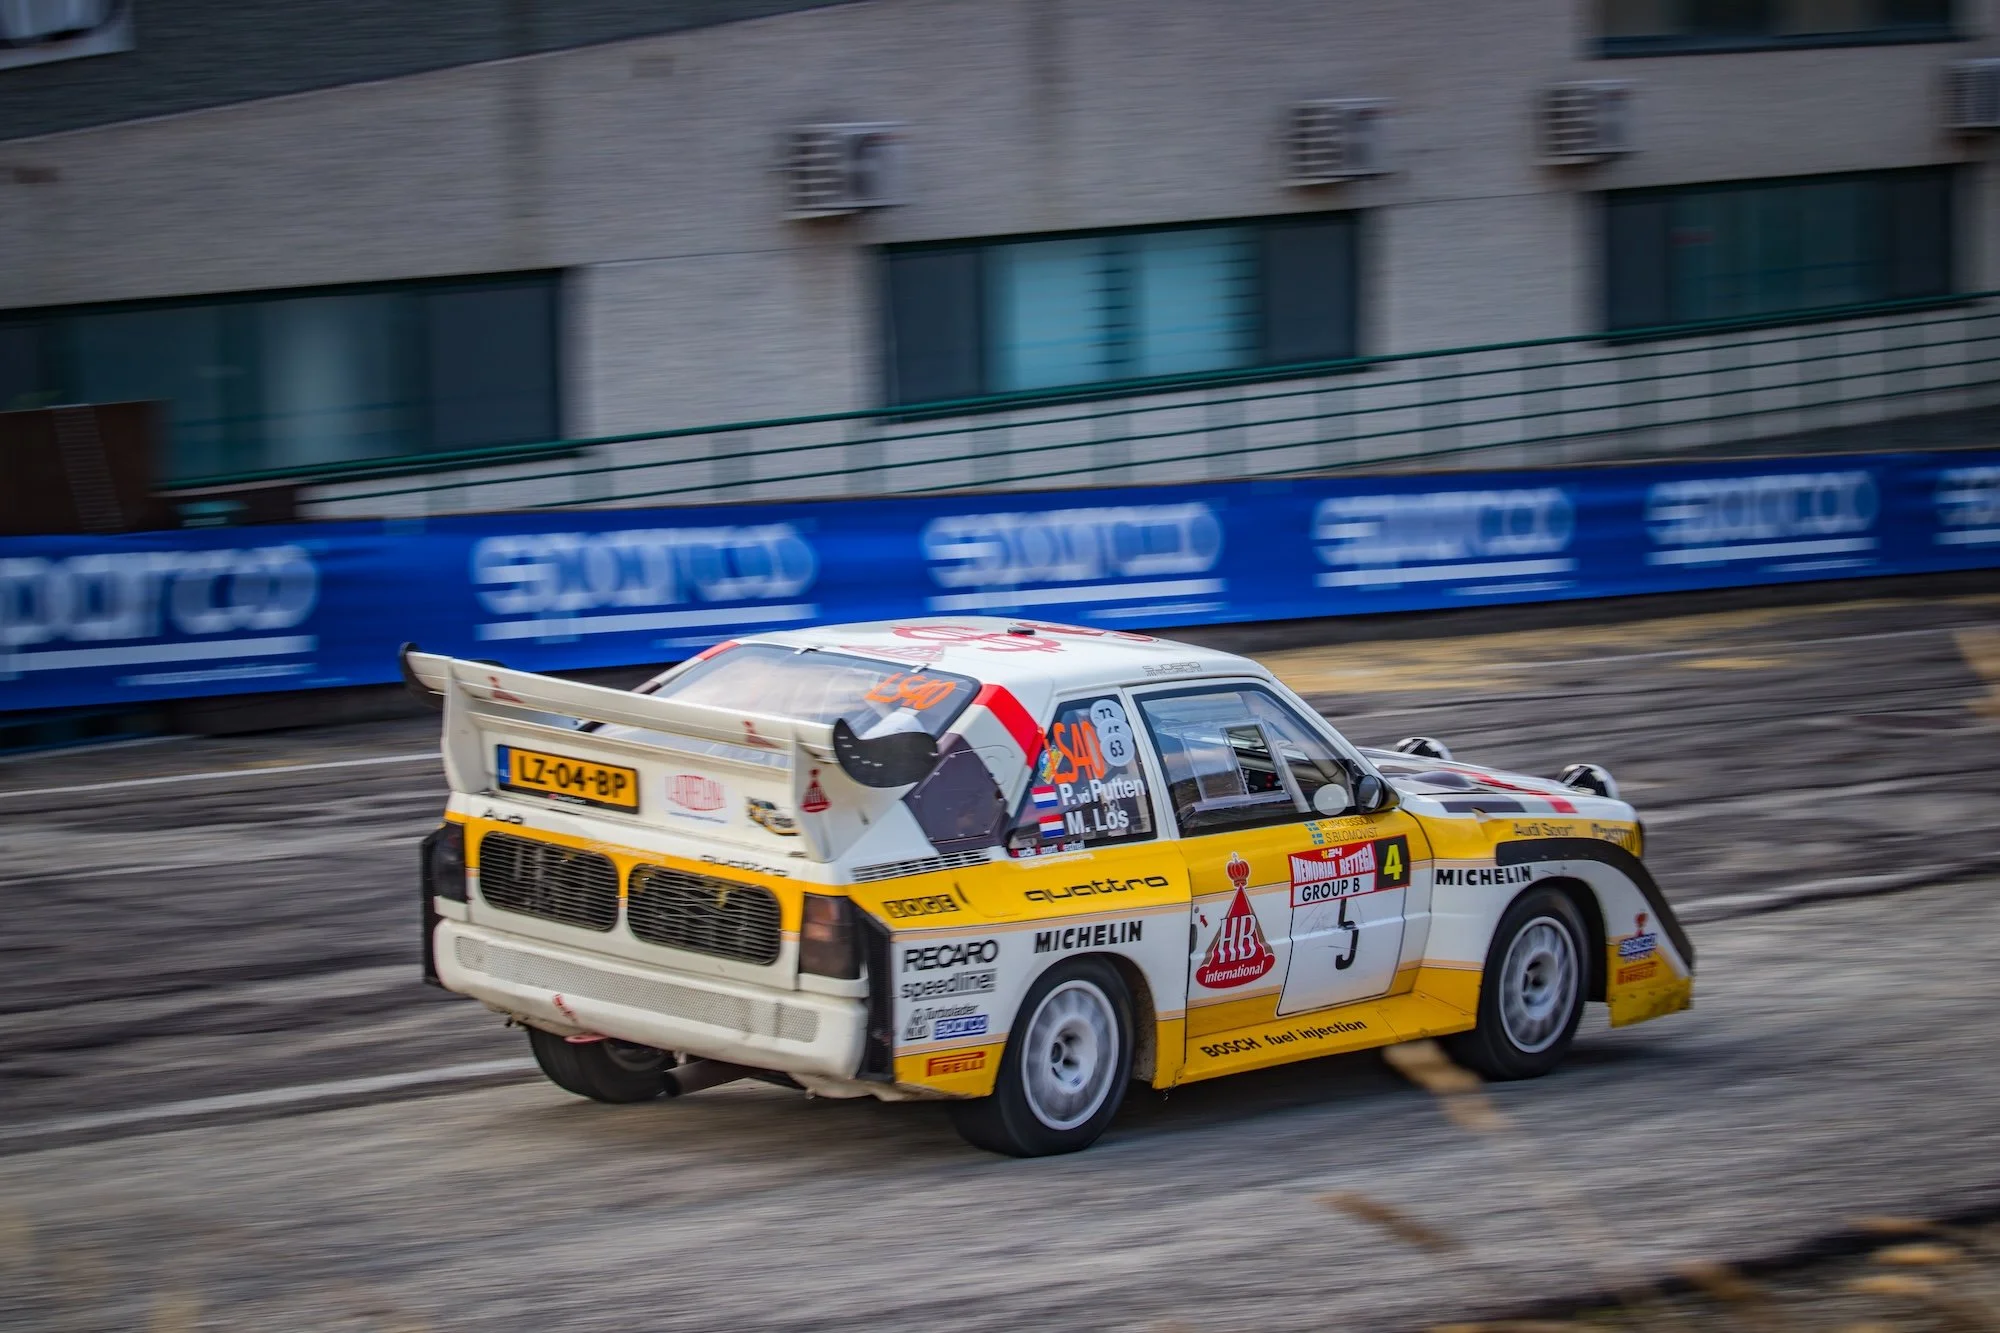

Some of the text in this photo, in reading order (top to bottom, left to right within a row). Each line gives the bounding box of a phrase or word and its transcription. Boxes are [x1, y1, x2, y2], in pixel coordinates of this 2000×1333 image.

[1110, 740, 1124, 757] 63
[518, 755, 626, 798] LZ-04-BP
[1058, 783, 1076, 806] P.
[1089, 777, 1146, 801] Putten
[1065, 809, 1129, 835] M. Los
[1291, 843, 1375, 884] MEMORIAL BETTEGA
[1384, 844, 1403, 881] 4
[1435, 865, 1532, 886] MICHELIN
[1024, 876, 1169, 903] quattro
[1302, 877, 1360, 902] GROUP B
[1035, 920, 1143, 953] MICHELIN
[1218, 914, 1257, 963] HB
[1335, 898, 1359, 970] 5
[902, 939, 1000, 973] RECARO
[1205, 960, 1265, 984] international
[1199, 1019, 1368, 1058] BOSCH fuel injection
[926, 1051, 986, 1077] PIRELLI
